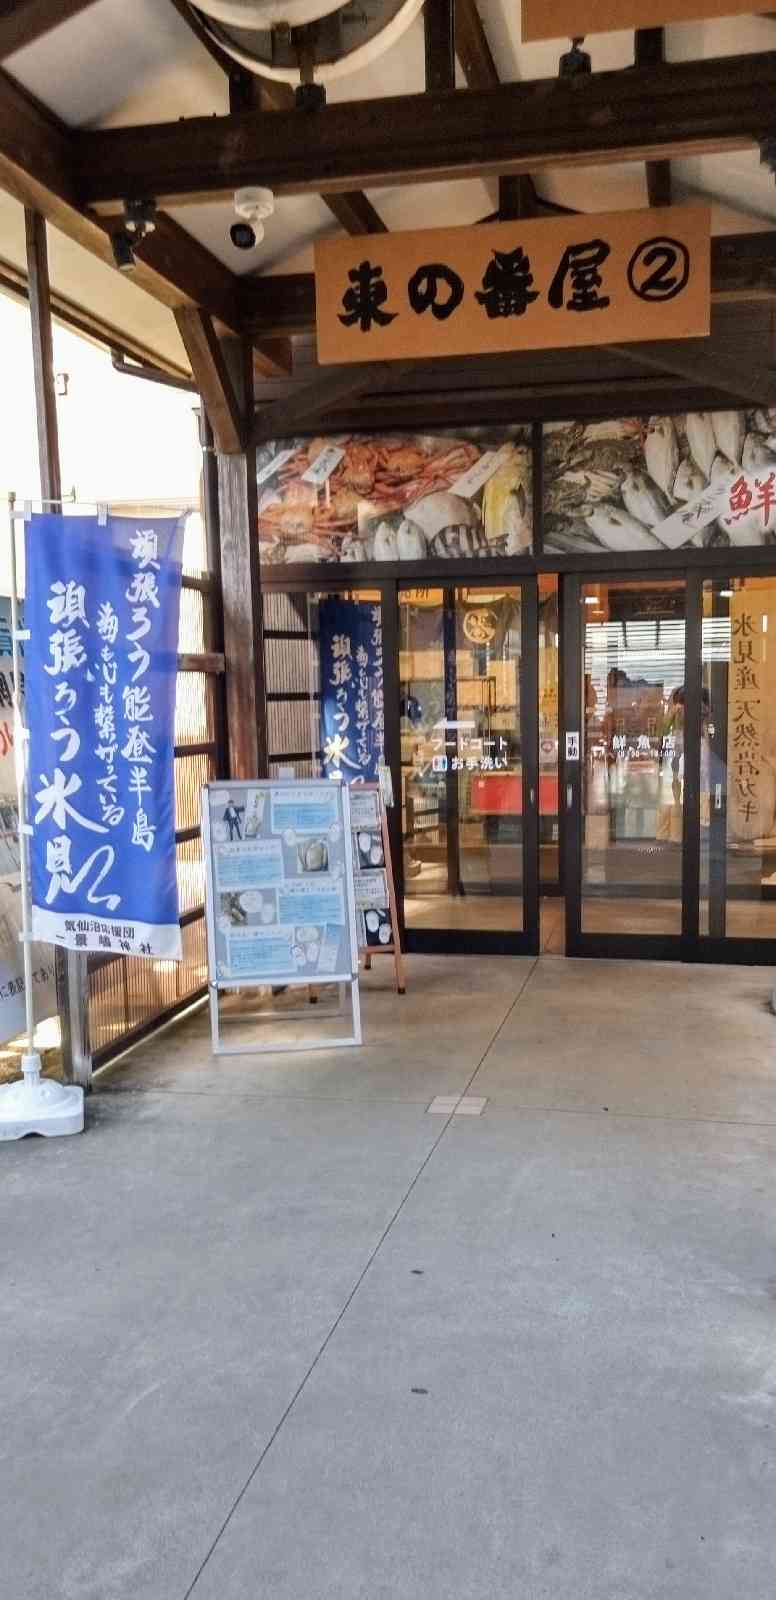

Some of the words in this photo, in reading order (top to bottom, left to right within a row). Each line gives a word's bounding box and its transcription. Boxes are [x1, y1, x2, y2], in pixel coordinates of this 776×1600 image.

[431, 736, 508, 752] フードコート
[451, 753, 508, 770] お手洗い
